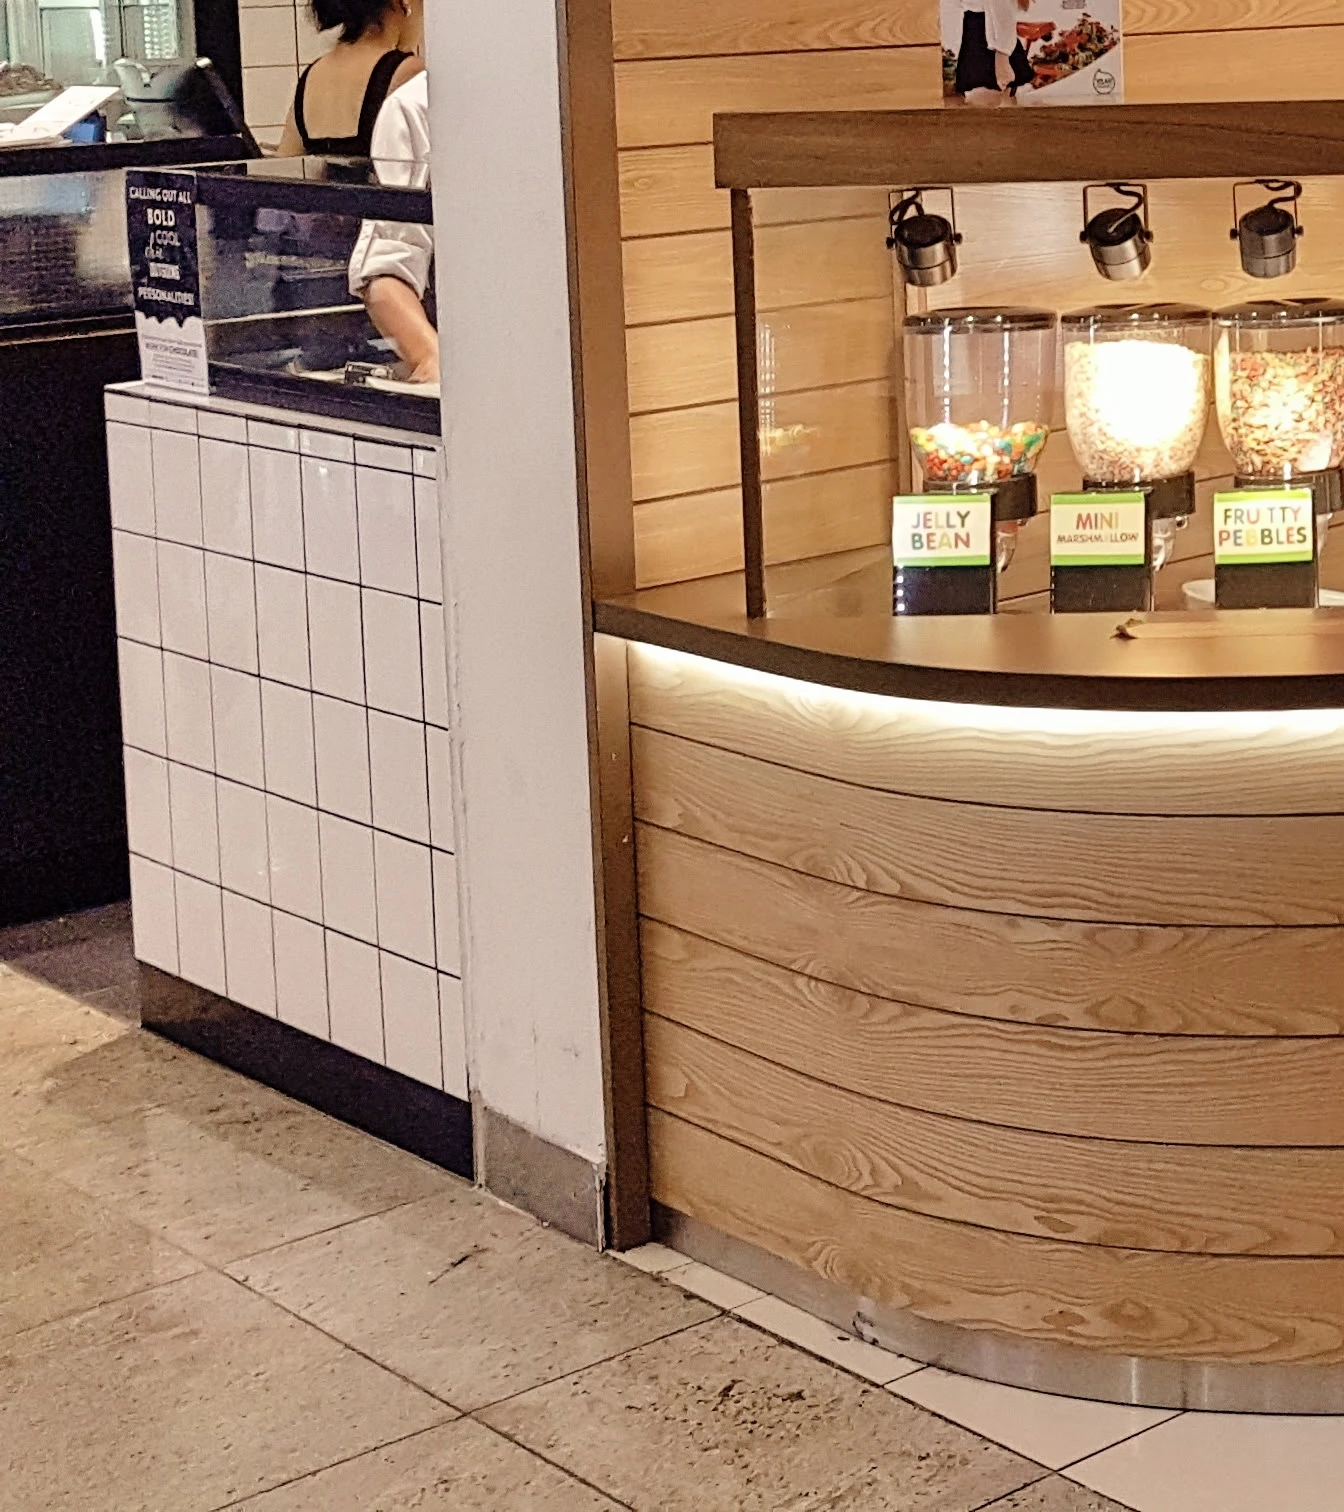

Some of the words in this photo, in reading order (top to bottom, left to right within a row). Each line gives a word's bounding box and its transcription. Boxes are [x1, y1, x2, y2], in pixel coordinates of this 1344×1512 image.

[129, 186, 162, 202] CALLING
[161, 189, 177, 202] OUT
[177, 190, 192, 204] ALL
[146, 208, 176, 227] BOLD
[911, 510, 971, 529] JELLY
[1075, 511, 1119, 530] MINI
[1224, 506, 1301, 526] FRUTTY
[911, 531, 971, 551] BEAN
[1056, 532, 1140, 544] MARSHMLLOW
[1218, 526, 1308, 548] PEBBLES
